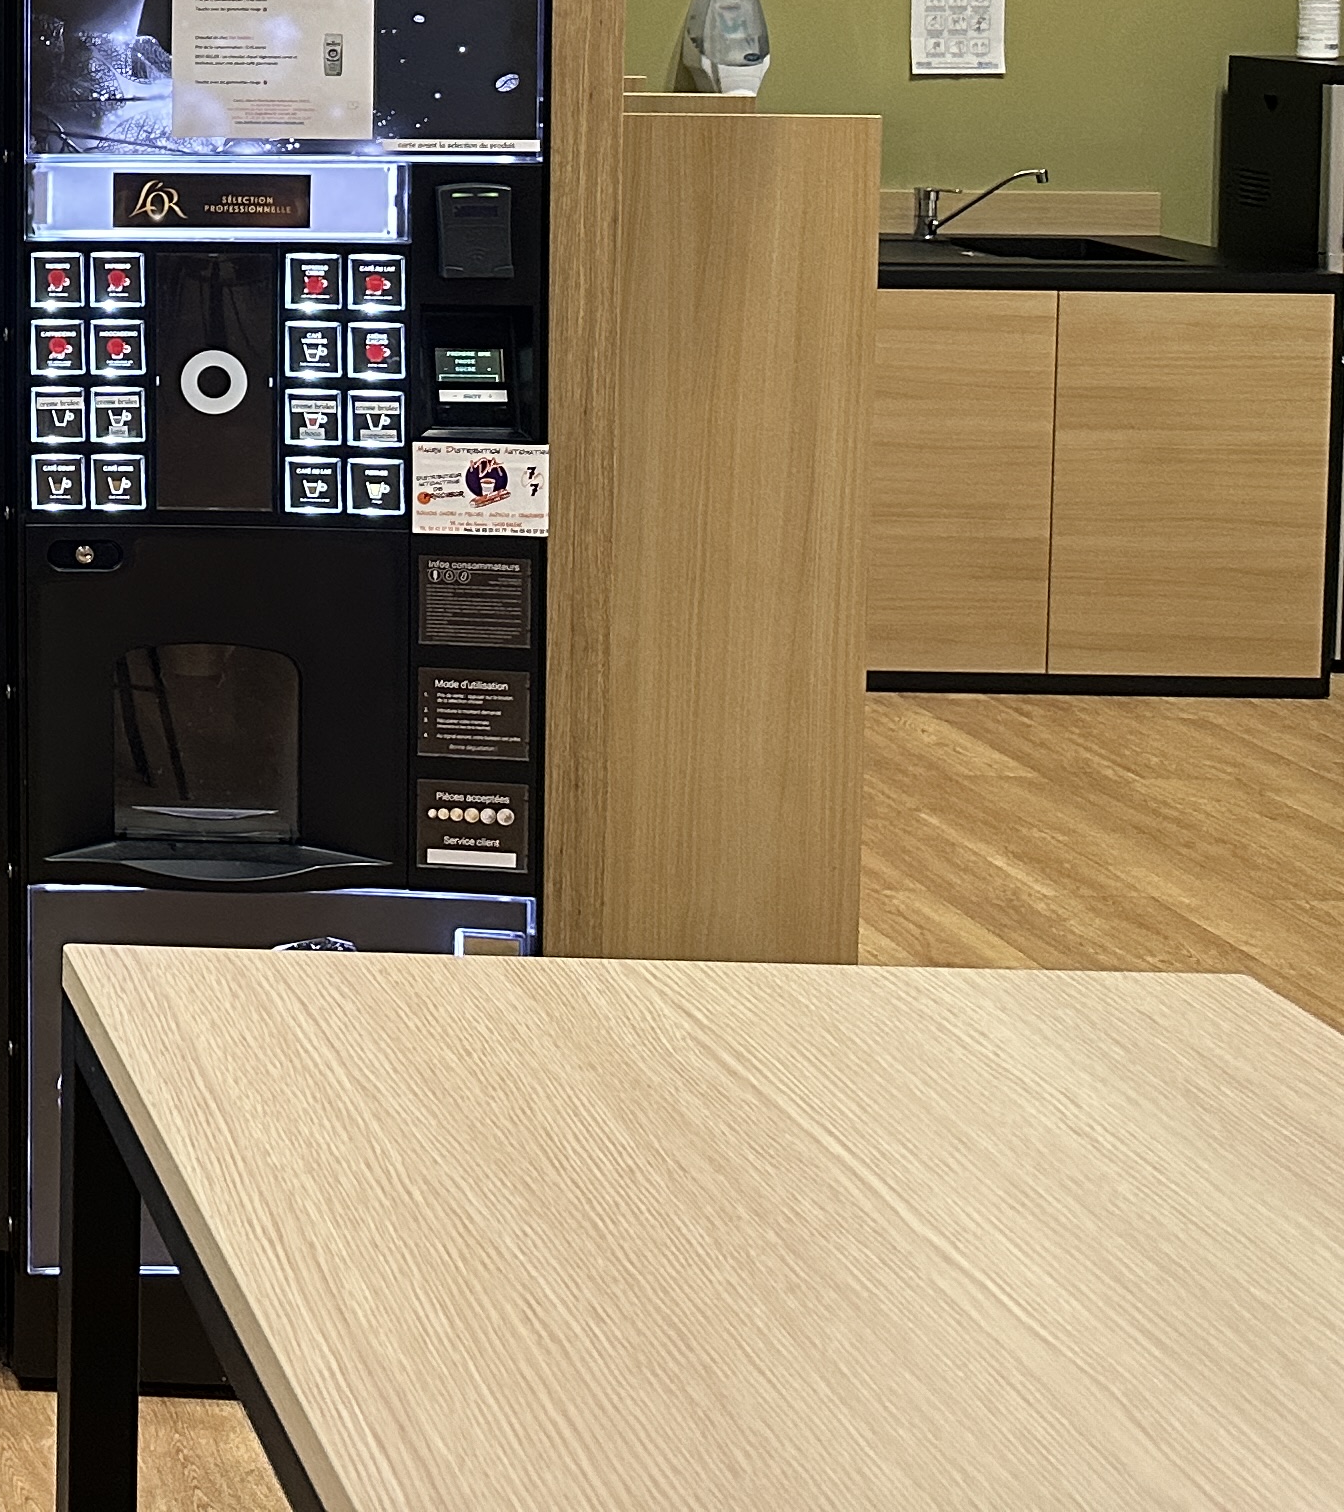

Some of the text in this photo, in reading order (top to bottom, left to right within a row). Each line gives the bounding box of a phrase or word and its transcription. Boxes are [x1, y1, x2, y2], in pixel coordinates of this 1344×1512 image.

[221, 193, 274, 204] SÉLECTION
[204, 204, 292, 214] PROFESSIONNELLE
[526, 466, 537, 479] 7
[529, 483, 540, 497] 7
[428, 560, 520, 572] Infos consommateurs
[434, 679, 509, 691] Mode d'utilisation
[436, 791, 510, 805] Pièces acceptées
[443, 836, 500, 848] Service client
